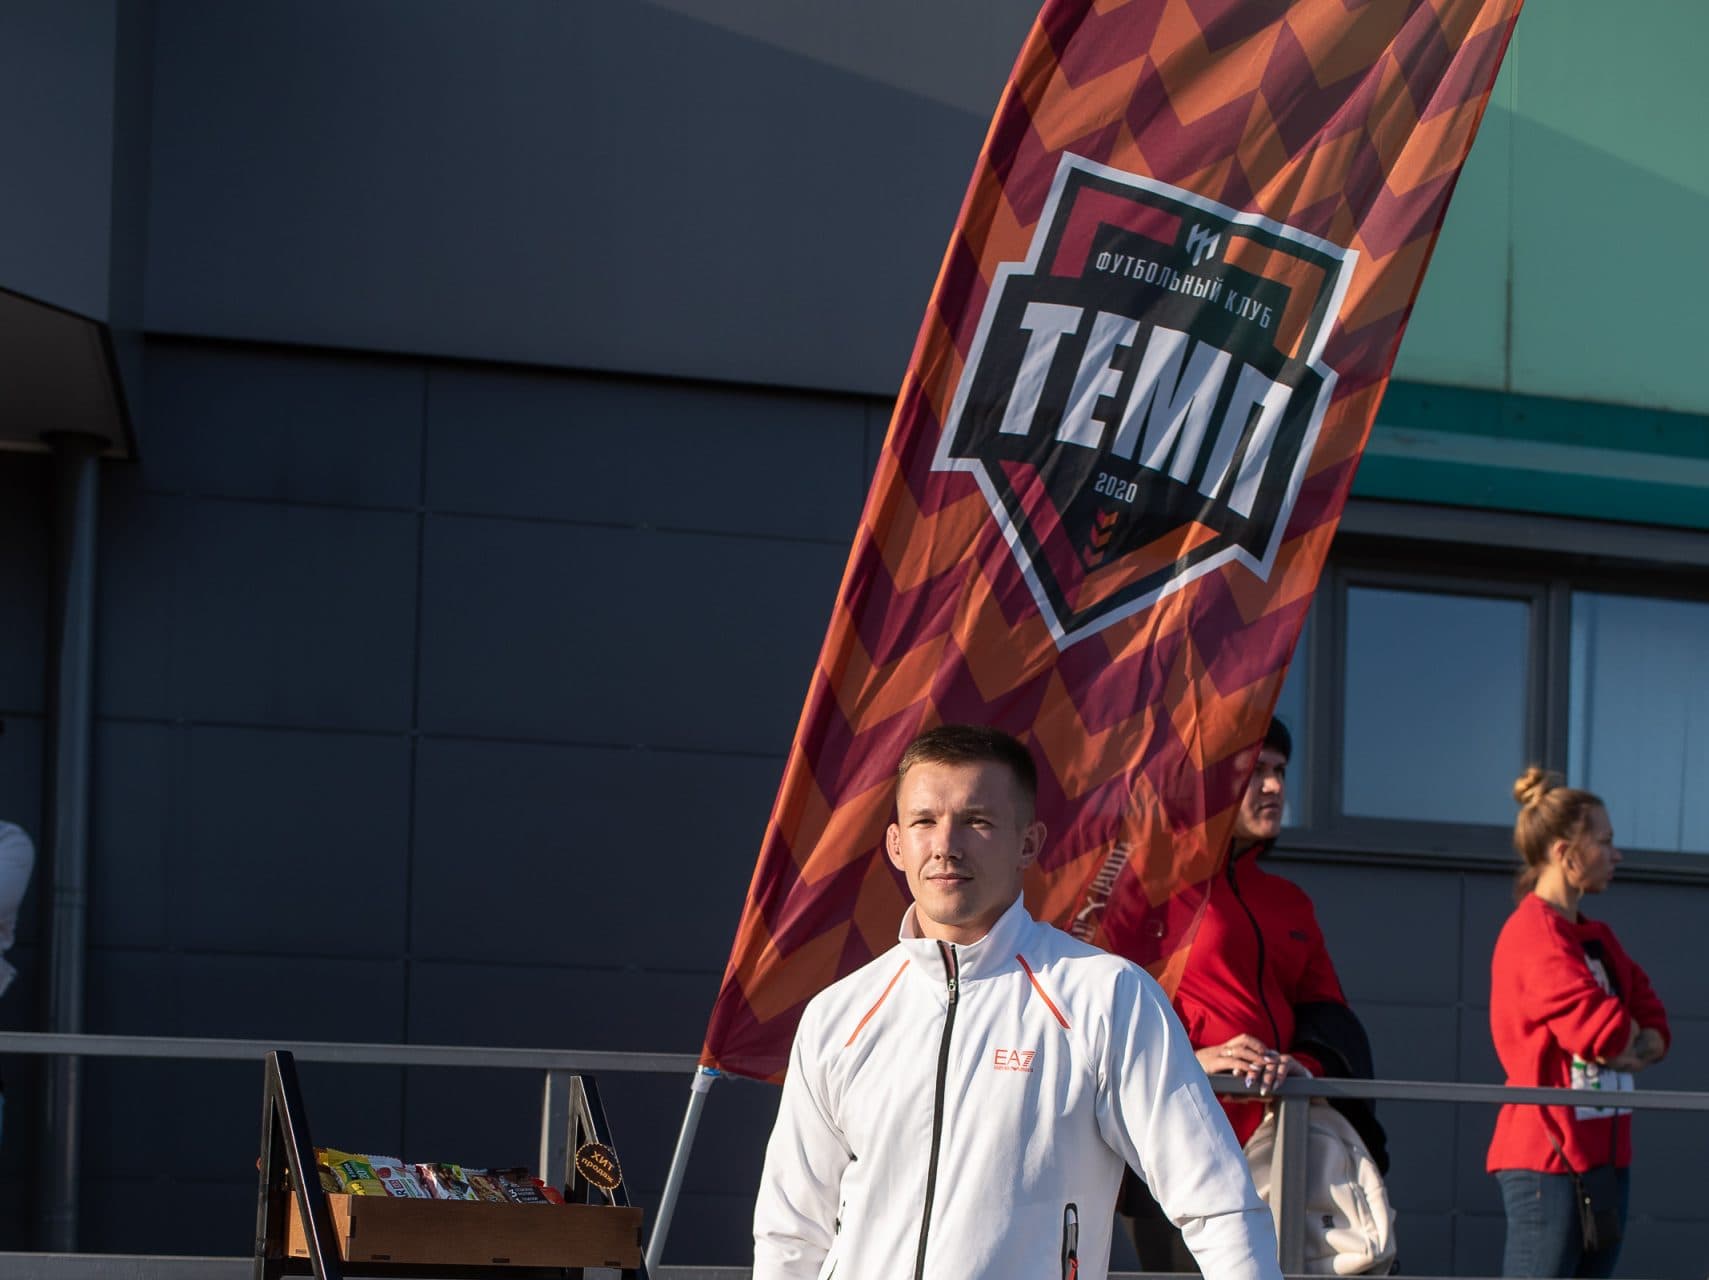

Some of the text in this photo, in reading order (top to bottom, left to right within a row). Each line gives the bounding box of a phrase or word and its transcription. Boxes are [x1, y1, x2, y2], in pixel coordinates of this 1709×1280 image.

[1096, 251, 1273, 329] ФУТБОЛЬНЫЙ КЛУБ
[999, 302, 1293, 519] ТЕМП
[1094, 471, 1138, 504] 2020
[994, 1049, 1037, 1067] EA7
[591, 1151, 615, 1171] ХИТ
